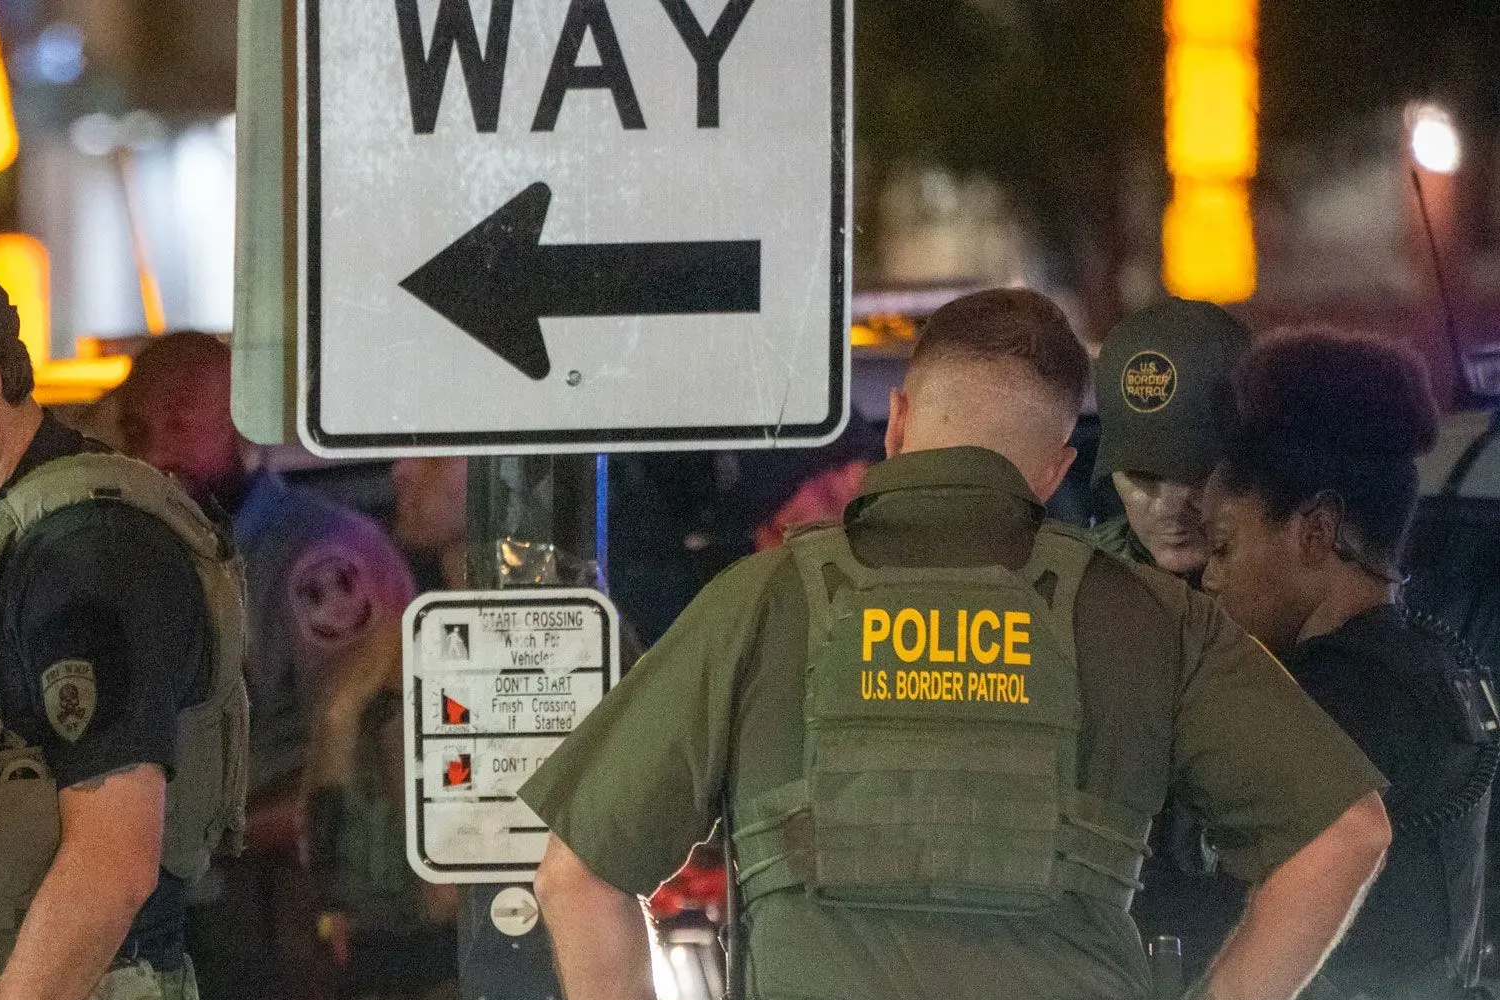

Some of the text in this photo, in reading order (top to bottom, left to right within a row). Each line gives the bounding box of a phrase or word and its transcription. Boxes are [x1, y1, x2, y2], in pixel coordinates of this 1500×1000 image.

[396, 0, 755, 135] WAY
[1128, 374, 1168, 385] BORDER
[1128, 386, 1165, 396] PATROL
[482, 611, 582, 629] START CROSSING
[862, 608, 1031, 665] POLICE
[495, 676, 573, 693] DON'T START
[861, 671, 1029, 704] U.S. BORDER PATROL
[492, 699, 576, 716] Finish Crossing
[508, 714, 572, 730] If Started
[493, 758, 527, 773] DON'T
